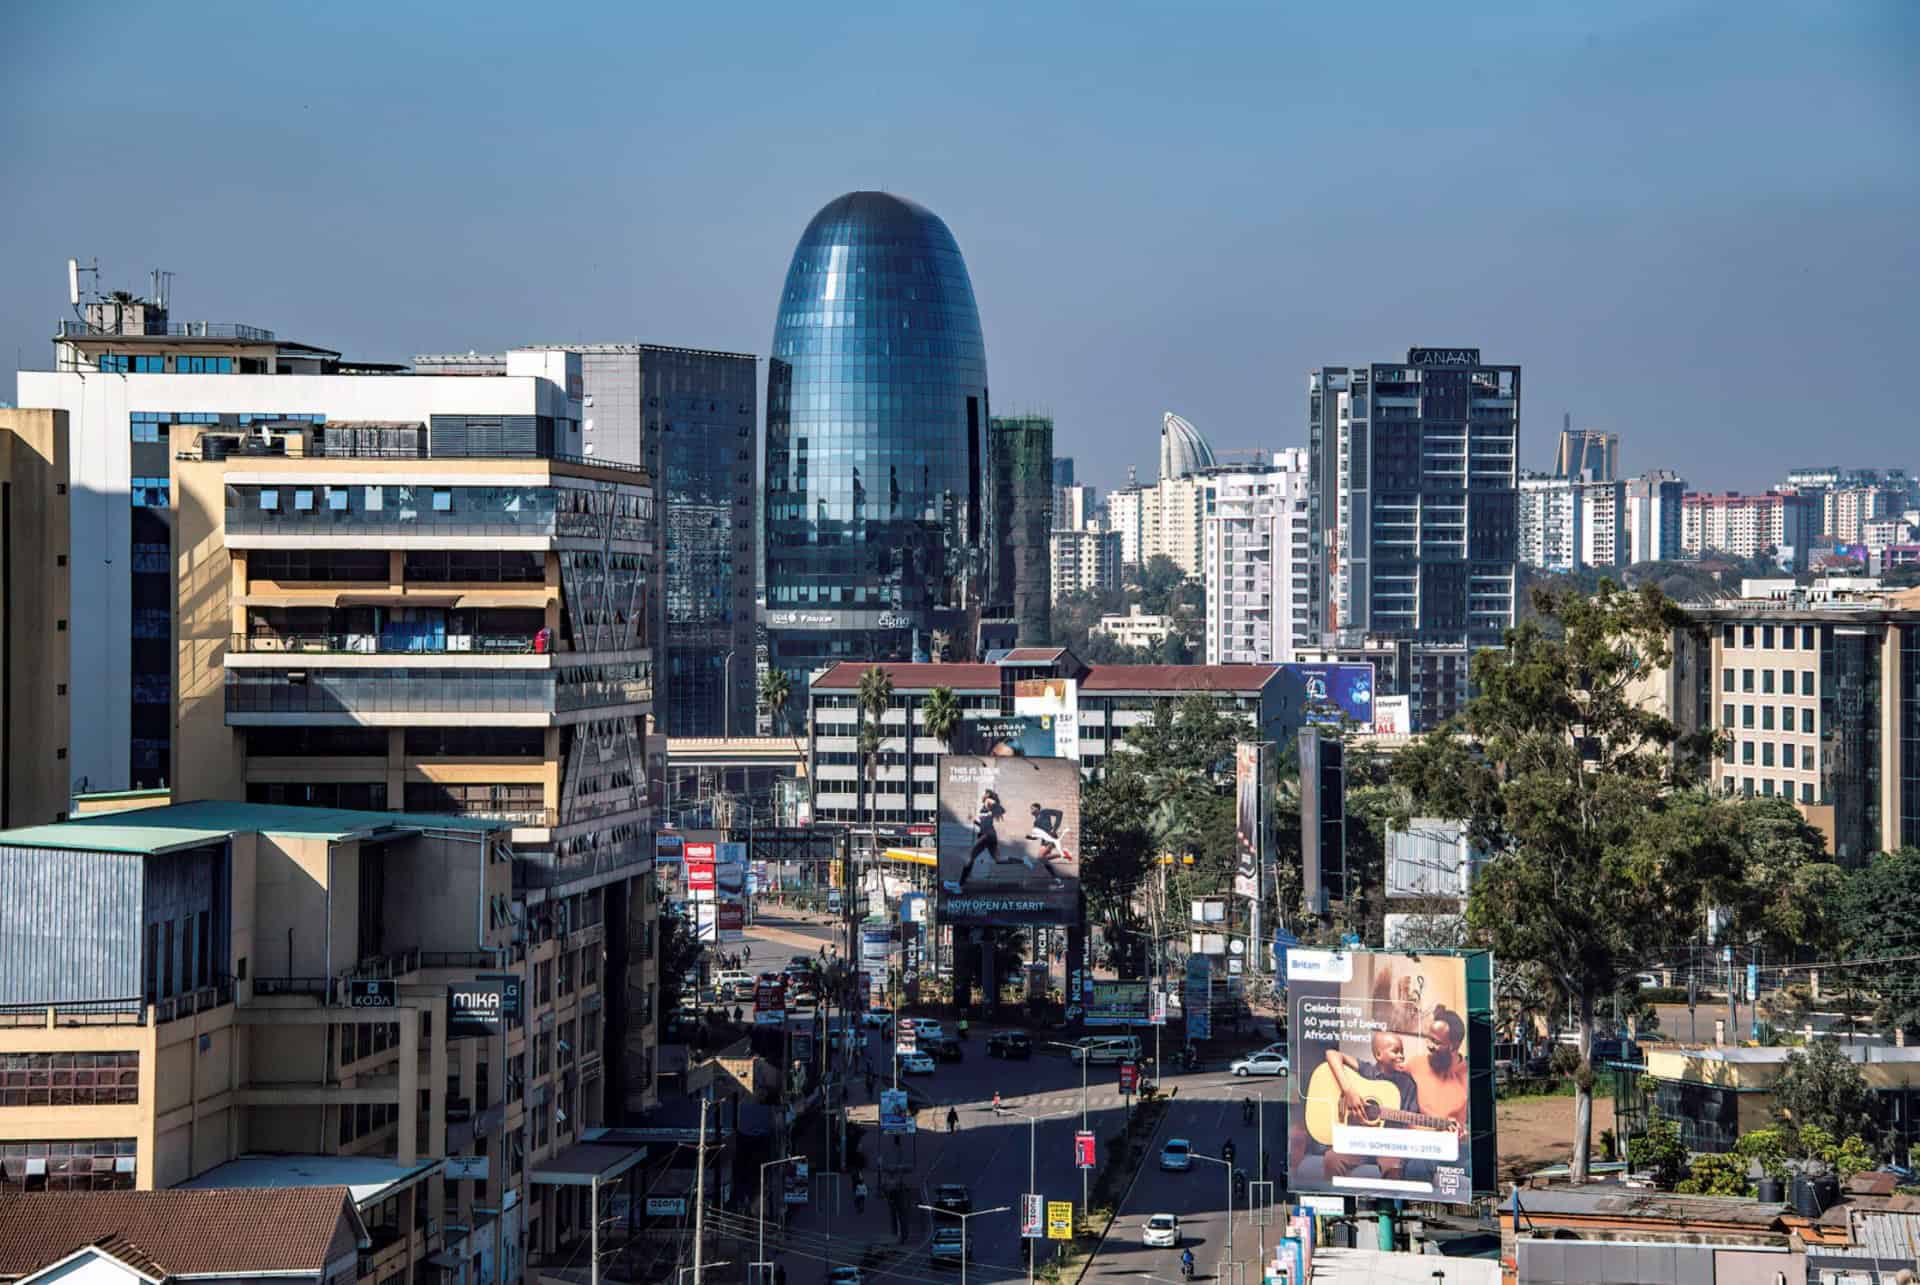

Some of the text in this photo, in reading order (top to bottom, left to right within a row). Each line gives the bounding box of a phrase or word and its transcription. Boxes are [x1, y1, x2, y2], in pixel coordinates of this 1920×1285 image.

[1413, 351, 1478, 365] CANAAN
[947, 900, 1045, 911] NOW OPEN AT SARIT
[1037, 928, 1047, 955] NCBA
[907, 937, 917, 967] NCBA
[1291, 960, 1320, 969] Britam
[354, 995, 391, 1006] KODA
[453, 992, 500, 1008] MIKA
[1303, 1003, 1362, 1017] Celebrating
[1303, 1016, 1388, 1031] 60 years of being
[1303, 1030, 1371, 1041] Africa's friend
